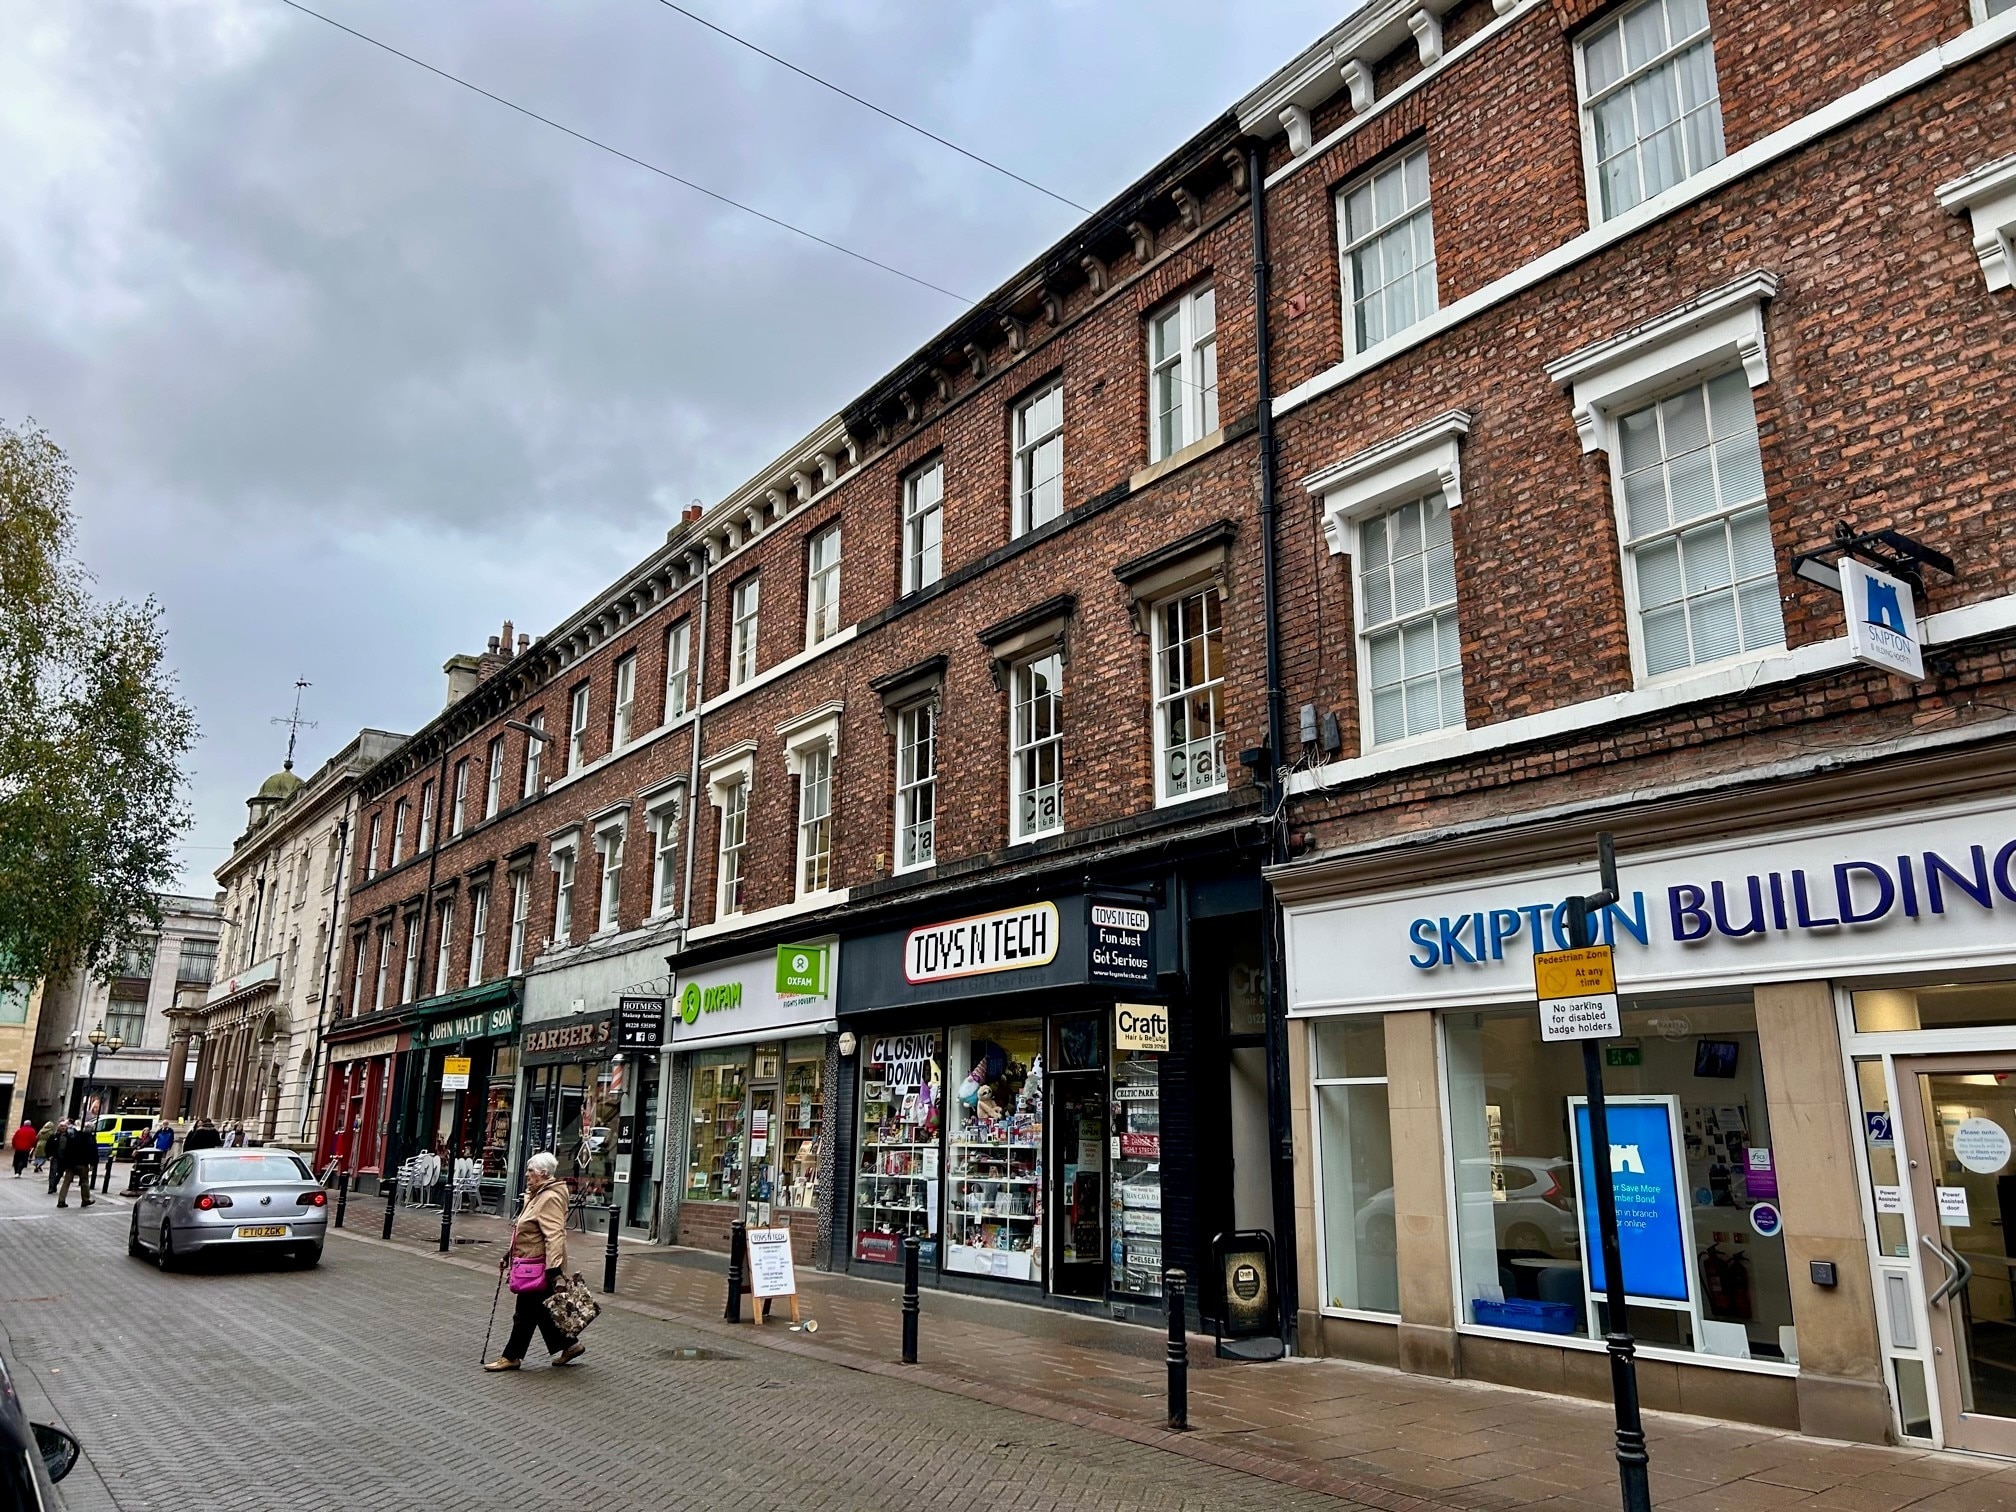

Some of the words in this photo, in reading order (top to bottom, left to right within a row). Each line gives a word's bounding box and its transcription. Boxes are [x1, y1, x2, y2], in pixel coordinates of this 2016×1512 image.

[1868, 625, 1912, 655] SKIPTON
[1095, 907, 1117, 925] TOYS
[1117, 910, 1125, 926] N
[1125, 911, 1146, 928] TECH
[1409, 891, 1649, 969] SKIPTON
[915, 927, 965, 974] TOYS
[970, 923, 986, 966] N
[992, 912, 1047, 962] TECH
[1099, 928, 1118, 945] Fun
[1119, 930, 1141, 947] Just
[1112, 950, 1148, 969] Serious
[1538, 953, 1584, 965] Pedestrian
[1586, 950, 1608, 960] Zone
[1575, 968, 1586, 977] At
[1587, 967, 1604, 978] any
[787, 976, 812, 987] OXFAM
[1580, 978, 1601, 988] time
[703, 982, 741, 1014] OXFAM
[1553, 1003, 1566, 1013] No
[1569, 1001, 1603, 1012] parking
[1552, 1014, 1565, 1024] for
[1568, 1010, 1606, 1022] disabled
[429, 1020, 453, 1041] JOHN
[455, 1014, 483, 1036] WATT
[491, 1007, 514, 1029] SON
[1118, 1010, 1167, 1038] Craft
[1548, 1025, 1575, 1035] badge
[1578, 1022, 1613, 1033] holders
[1125, 1033, 1138, 1042] Hair
[873, 1033, 935, 1062] CLOSING
[886, 1060, 923, 1087] DOWN
[1116, 1088, 1138, 1098] CELTIC
[1138, 1088, 1155, 1097] PARK
[622, 1125, 629, 1137] 15
[1620, 1183, 1639, 1192] Save
[1640, 1184, 1661, 1193] More
[1635, 1194, 1656, 1204] Bond
[1632, 1208, 1658, 1218] branch
[1623, 1219, 1647, 1229] online
[264, 1226, 281, 1236] ZGK
[1130, 1255, 1155, 1264] CHELSEA
